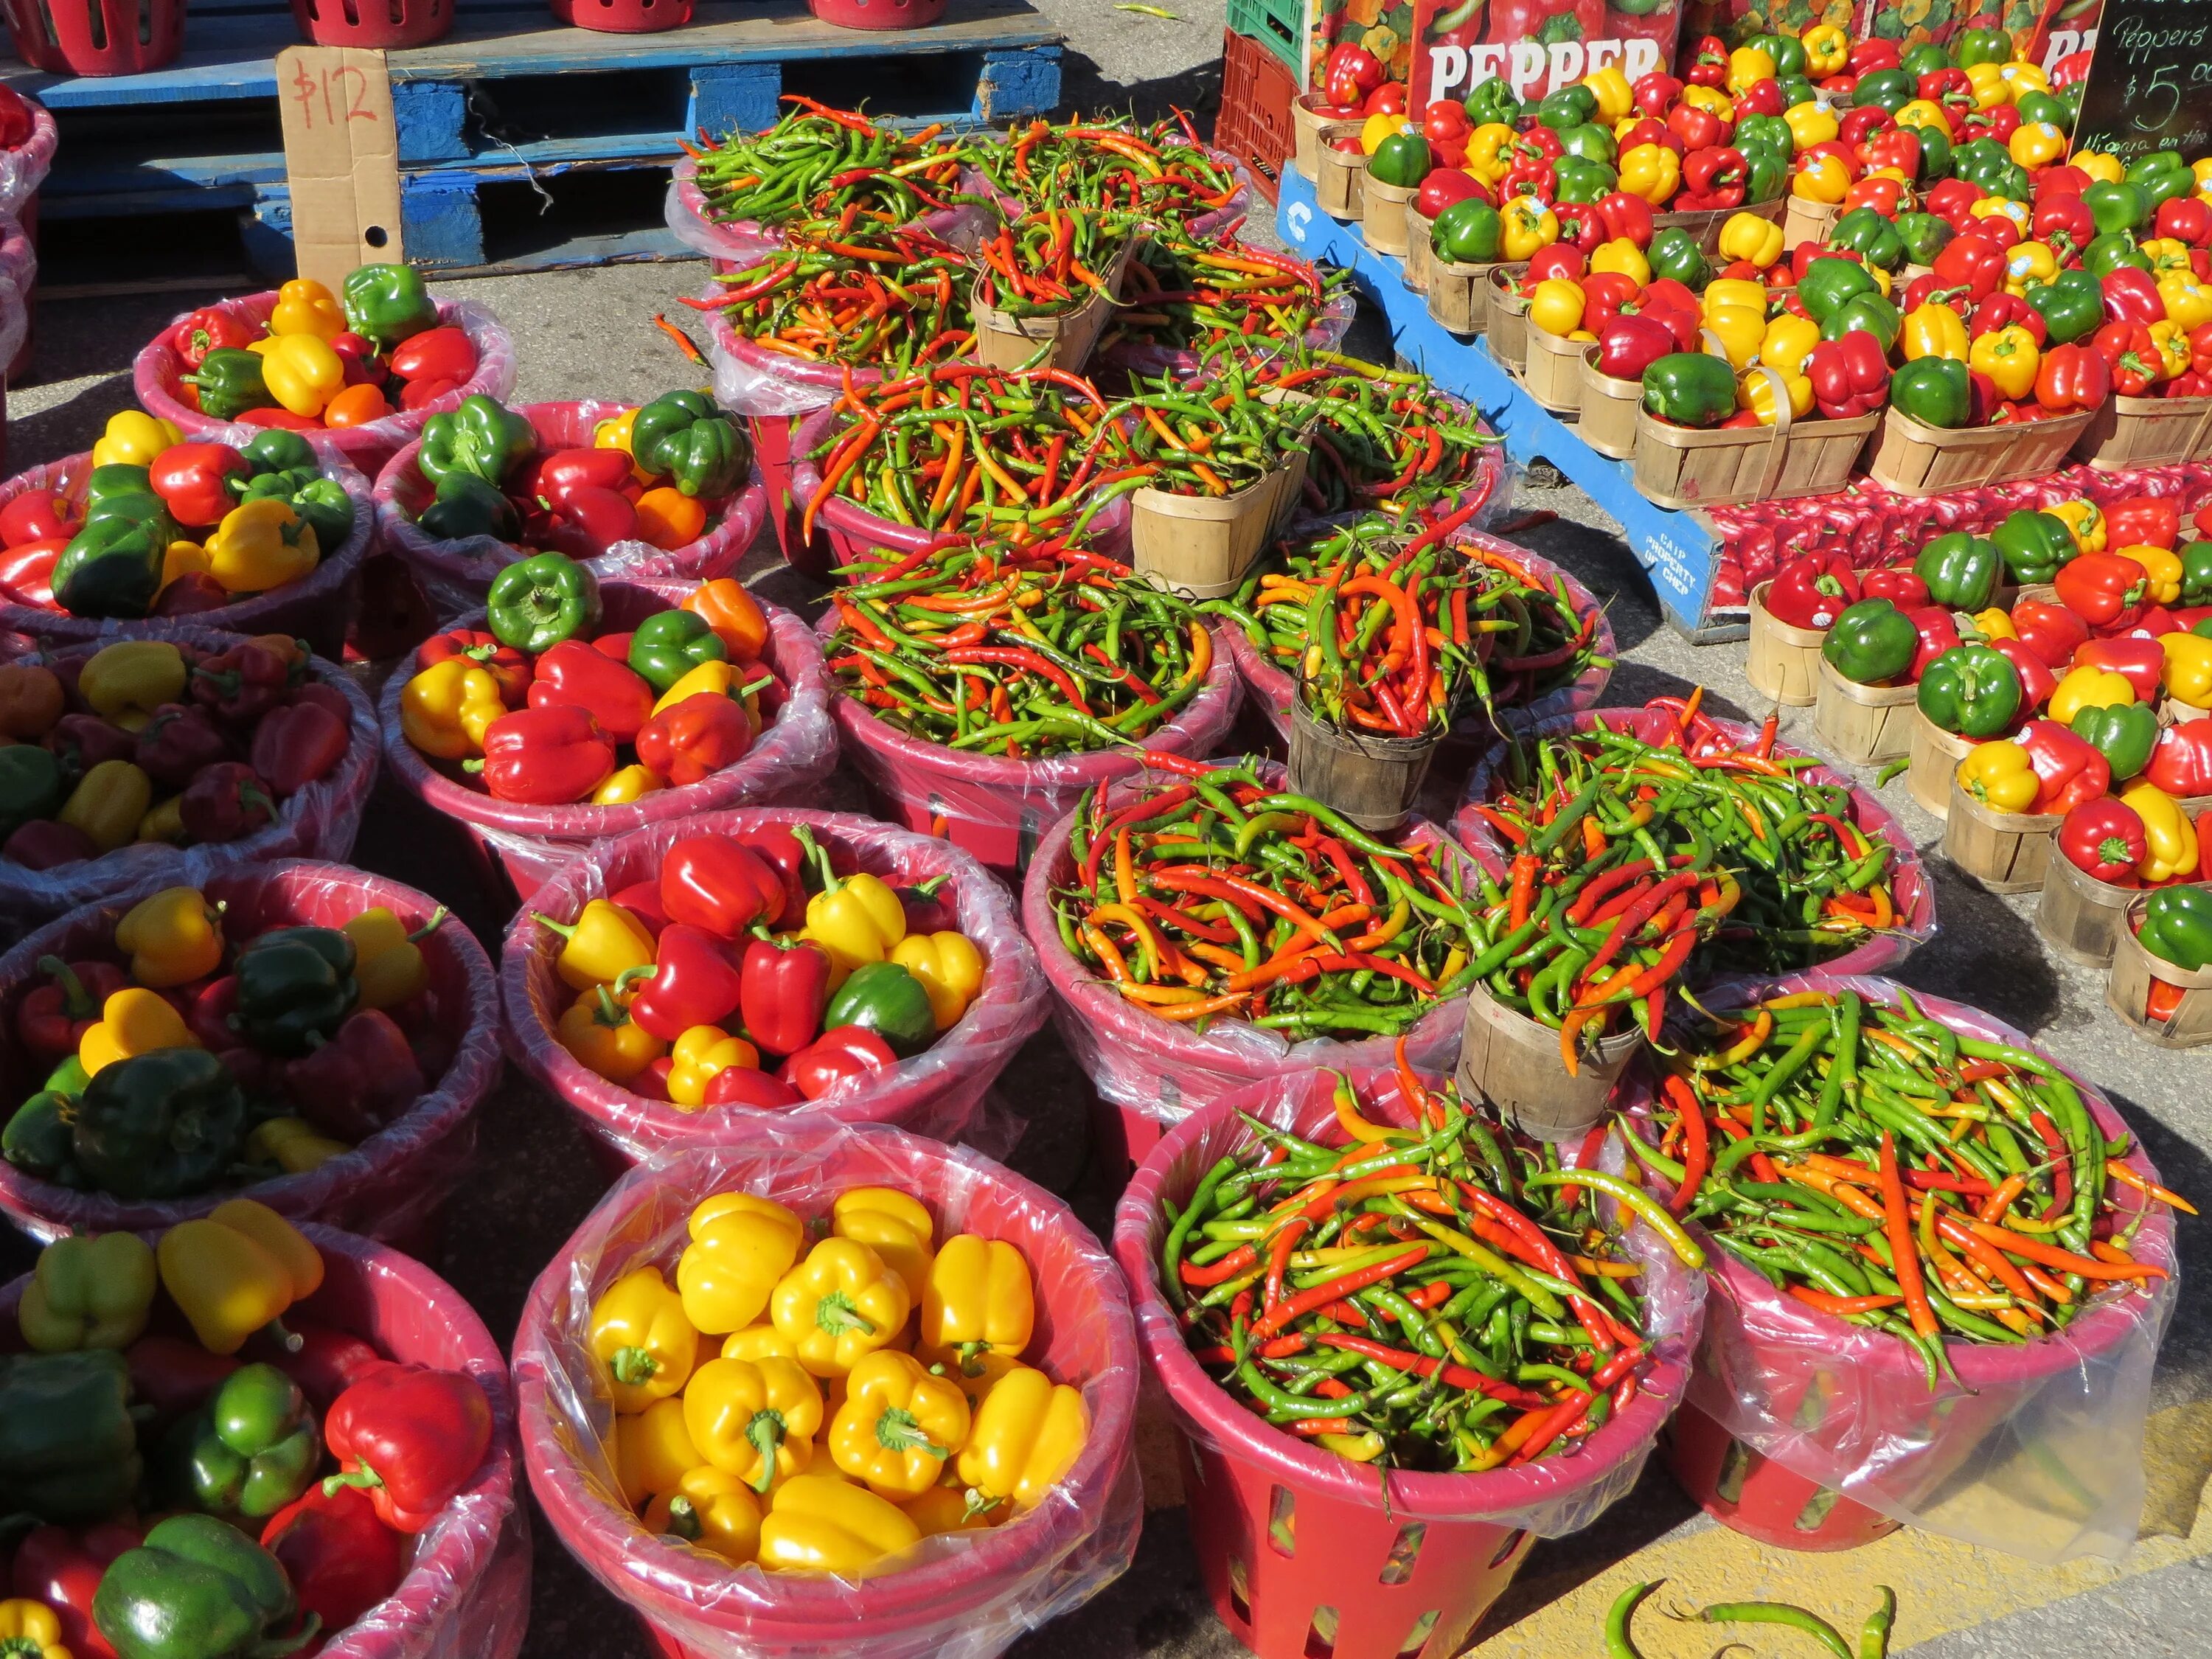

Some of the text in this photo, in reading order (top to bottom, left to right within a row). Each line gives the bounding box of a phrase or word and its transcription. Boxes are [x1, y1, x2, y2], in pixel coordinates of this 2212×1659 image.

[293, 58, 378, 130] $12
[1425, 38, 1660, 109] PEPPER
[1644, 549, 1689, 596] OF CHEP
[1646, 535, 1696, 588] PROPERTY
